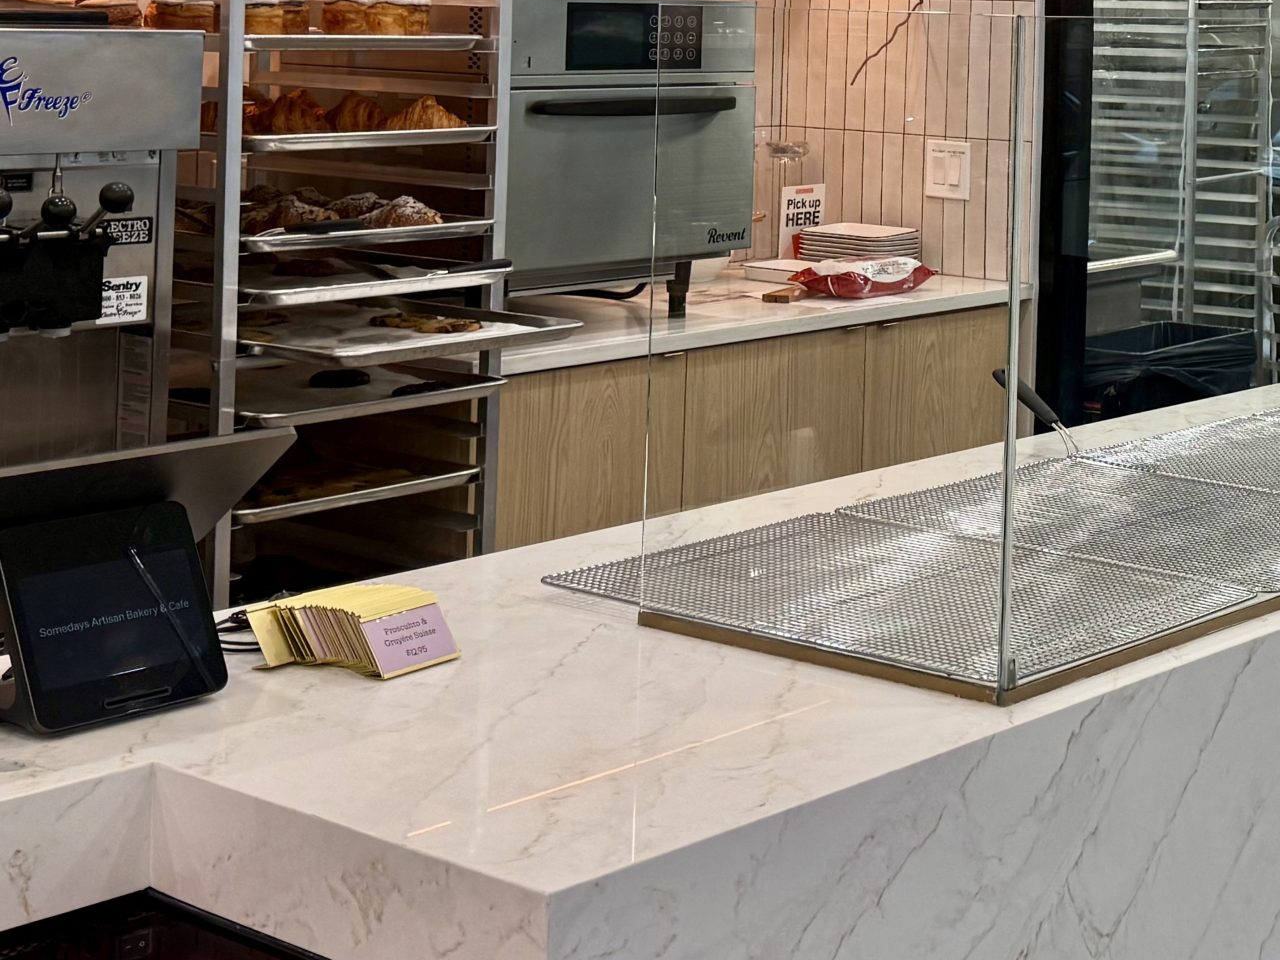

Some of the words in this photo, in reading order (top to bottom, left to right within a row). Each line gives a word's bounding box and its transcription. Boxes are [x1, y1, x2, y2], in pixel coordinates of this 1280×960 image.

[787, 198, 807, 210] Pick
[808, 198, 821, 211] up
[785, 210, 820, 227] HERE
[707, 227, 746, 244] Revent
[102, 280, 142, 292] Sentry
[39, 620, 90, 638] Somedays
[91, 612, 125, 627] Artisan
[125, 606, 158, 621] Bakery
